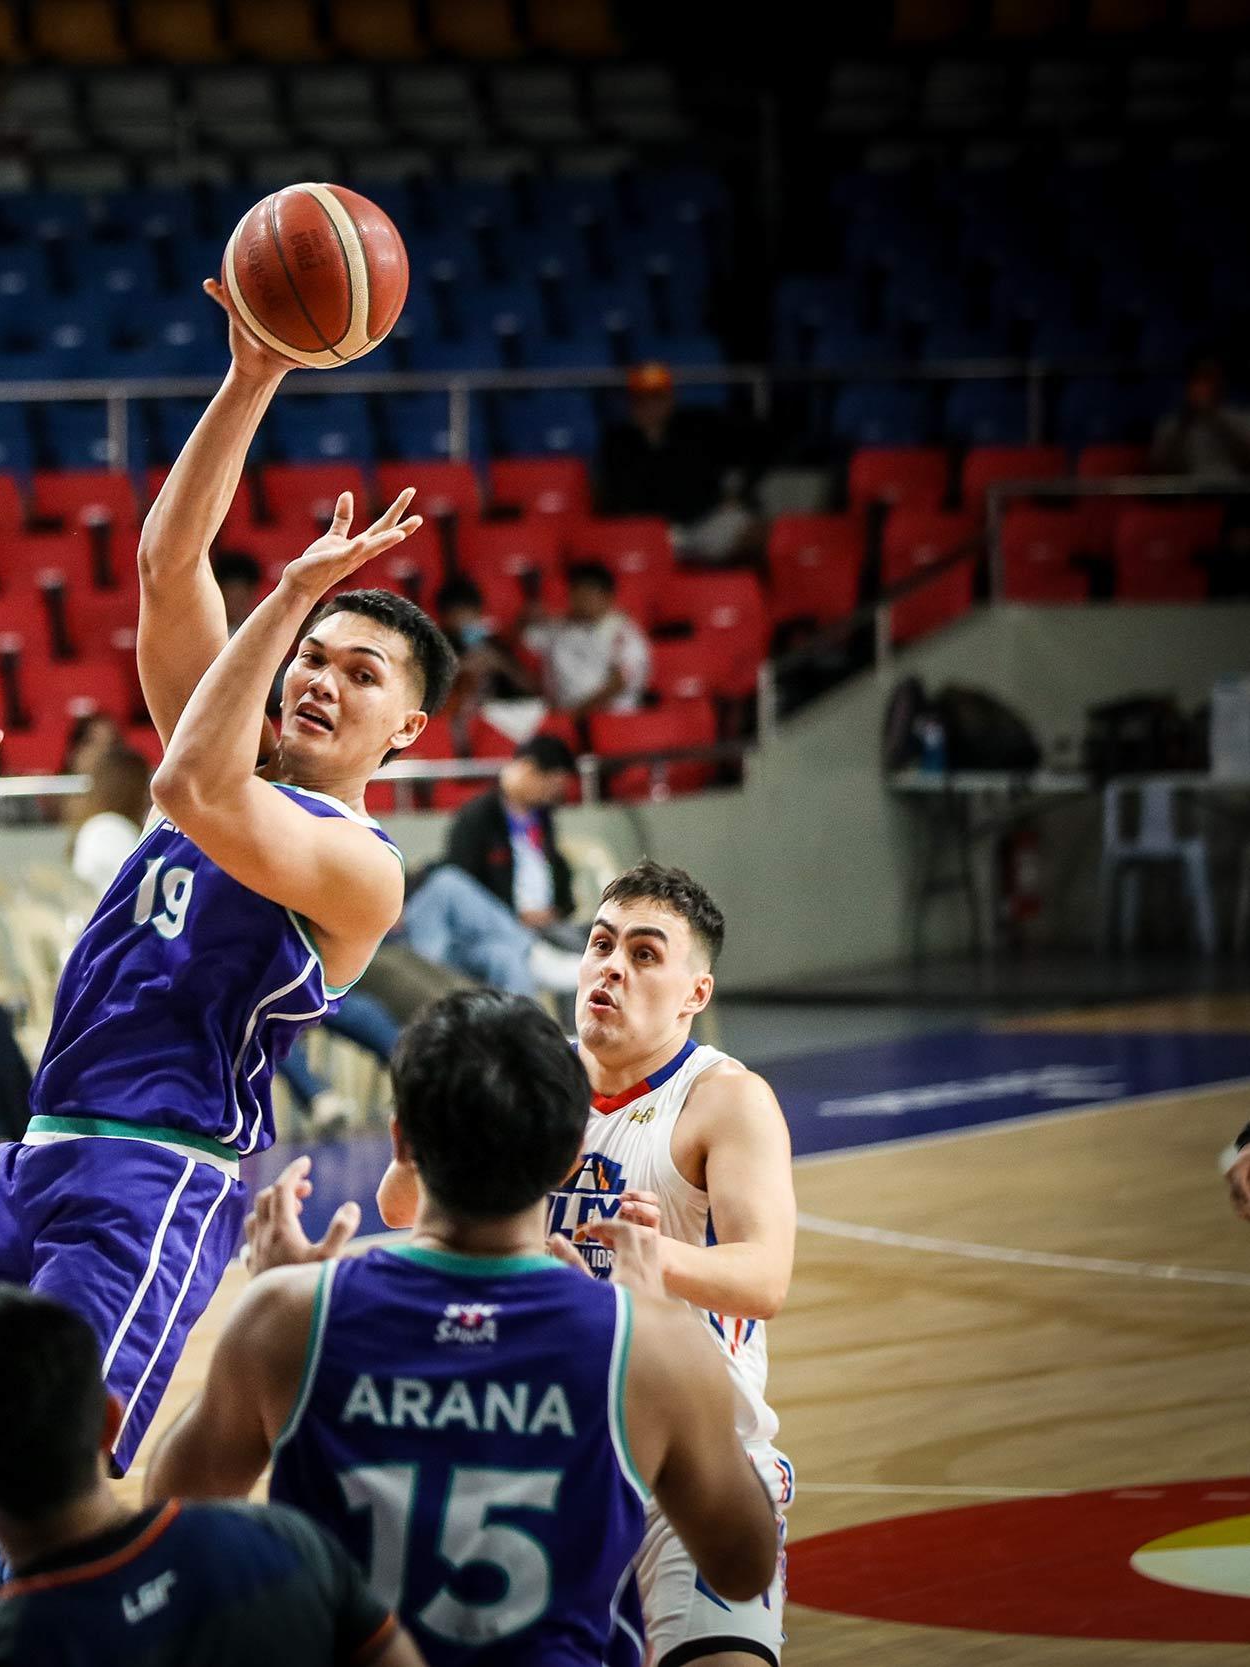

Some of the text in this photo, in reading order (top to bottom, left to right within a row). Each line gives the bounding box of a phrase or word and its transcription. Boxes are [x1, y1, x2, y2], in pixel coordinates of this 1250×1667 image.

[134, 856, 195, 940] 19
[340, 1372, 577, 1438] ARANA
[335, 1462, 565, 1646] 15
